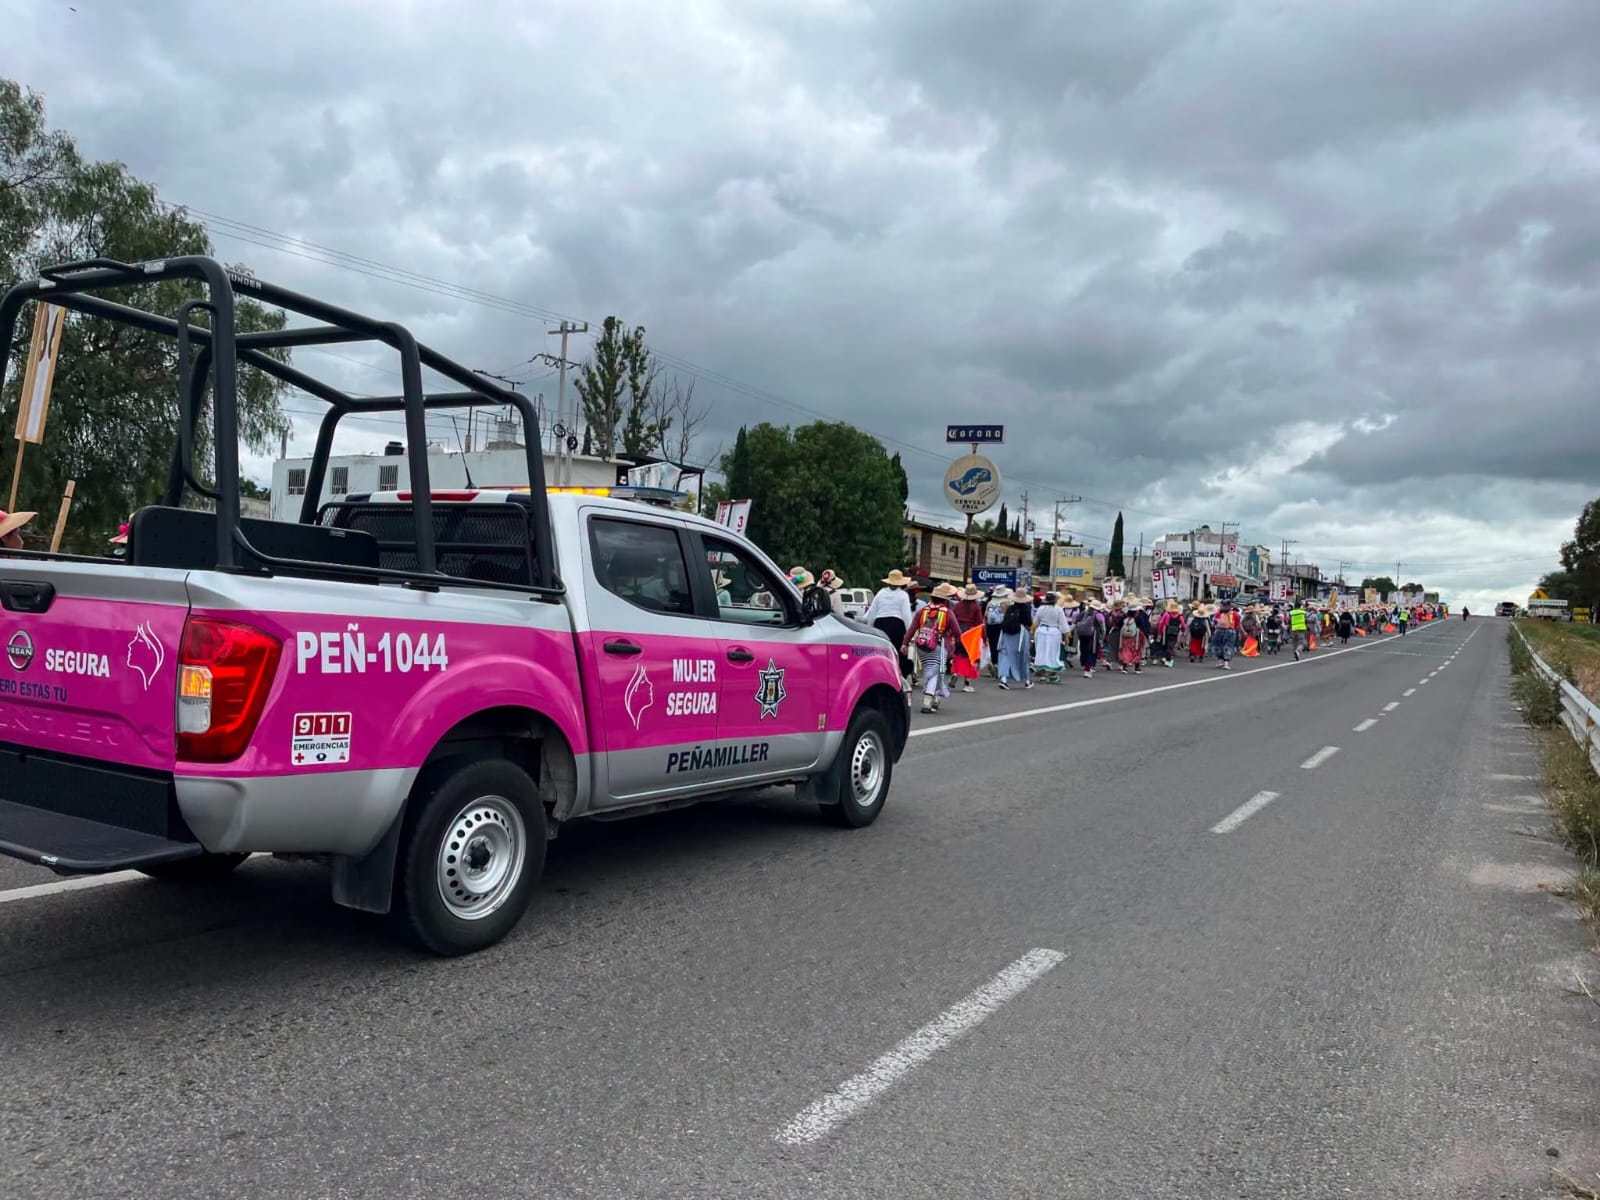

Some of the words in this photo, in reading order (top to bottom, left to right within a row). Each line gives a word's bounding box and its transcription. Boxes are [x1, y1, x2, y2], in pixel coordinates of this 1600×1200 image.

[948, 429, 1001, 439] Corona
[978, 570, 1007, 581] Corona
[296, 623, 449, 674] PEÑ-1044
[45, 648, 110, 678] SEGURA
[672, 658, 716, 682] MUJER
[20, 682, 51, 700] ESTAS
[53, 686, 68, 702] TU
[666, 692, 717, 716] SEGURA
[299, 717, 346, 733] 911
[294, 741, 349, 751] EMERGENCIAS
[666, 742, 769, 774] PEÑAMILLER
